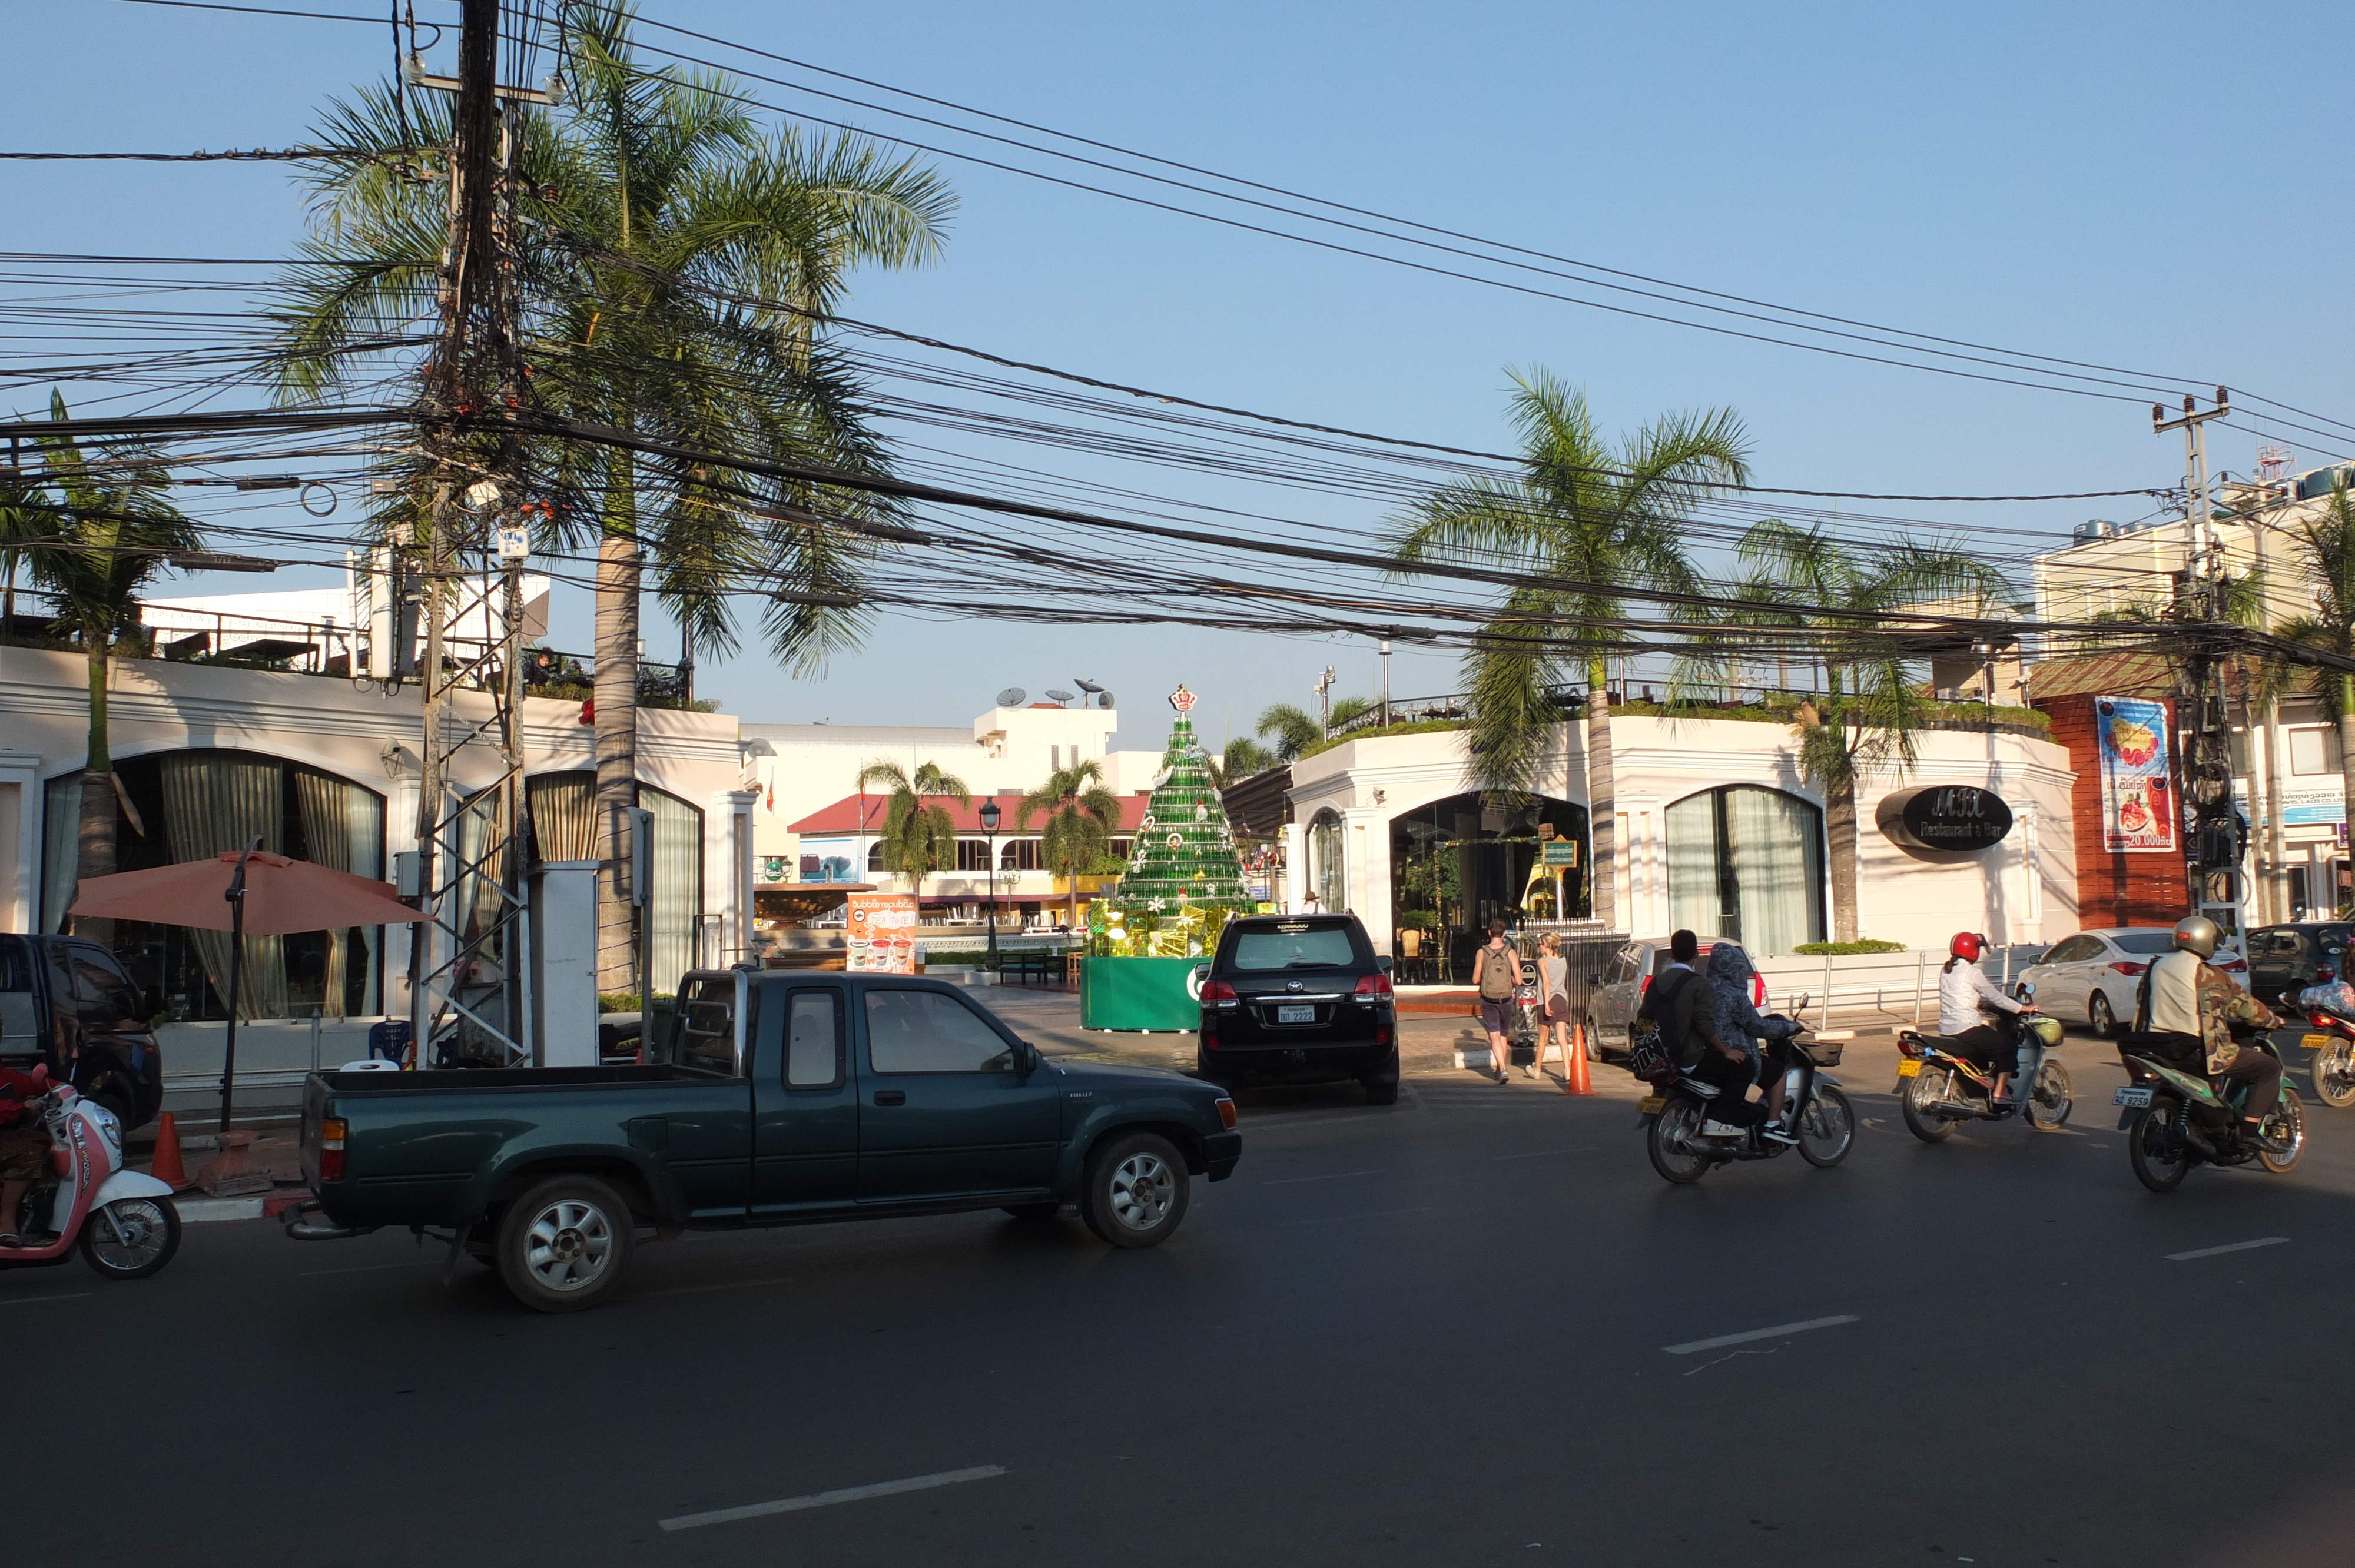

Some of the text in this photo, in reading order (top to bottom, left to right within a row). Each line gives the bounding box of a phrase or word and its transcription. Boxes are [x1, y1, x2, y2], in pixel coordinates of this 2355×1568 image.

[1920, 821, 1972, 837] Restaurant
[1983, 822, 2001, 838] Bar
[871, 916, 886, 925] TEA
[1293, 1012, 1313, 1021] 2222
[2128, 1097, 2148, 1106] 9259
